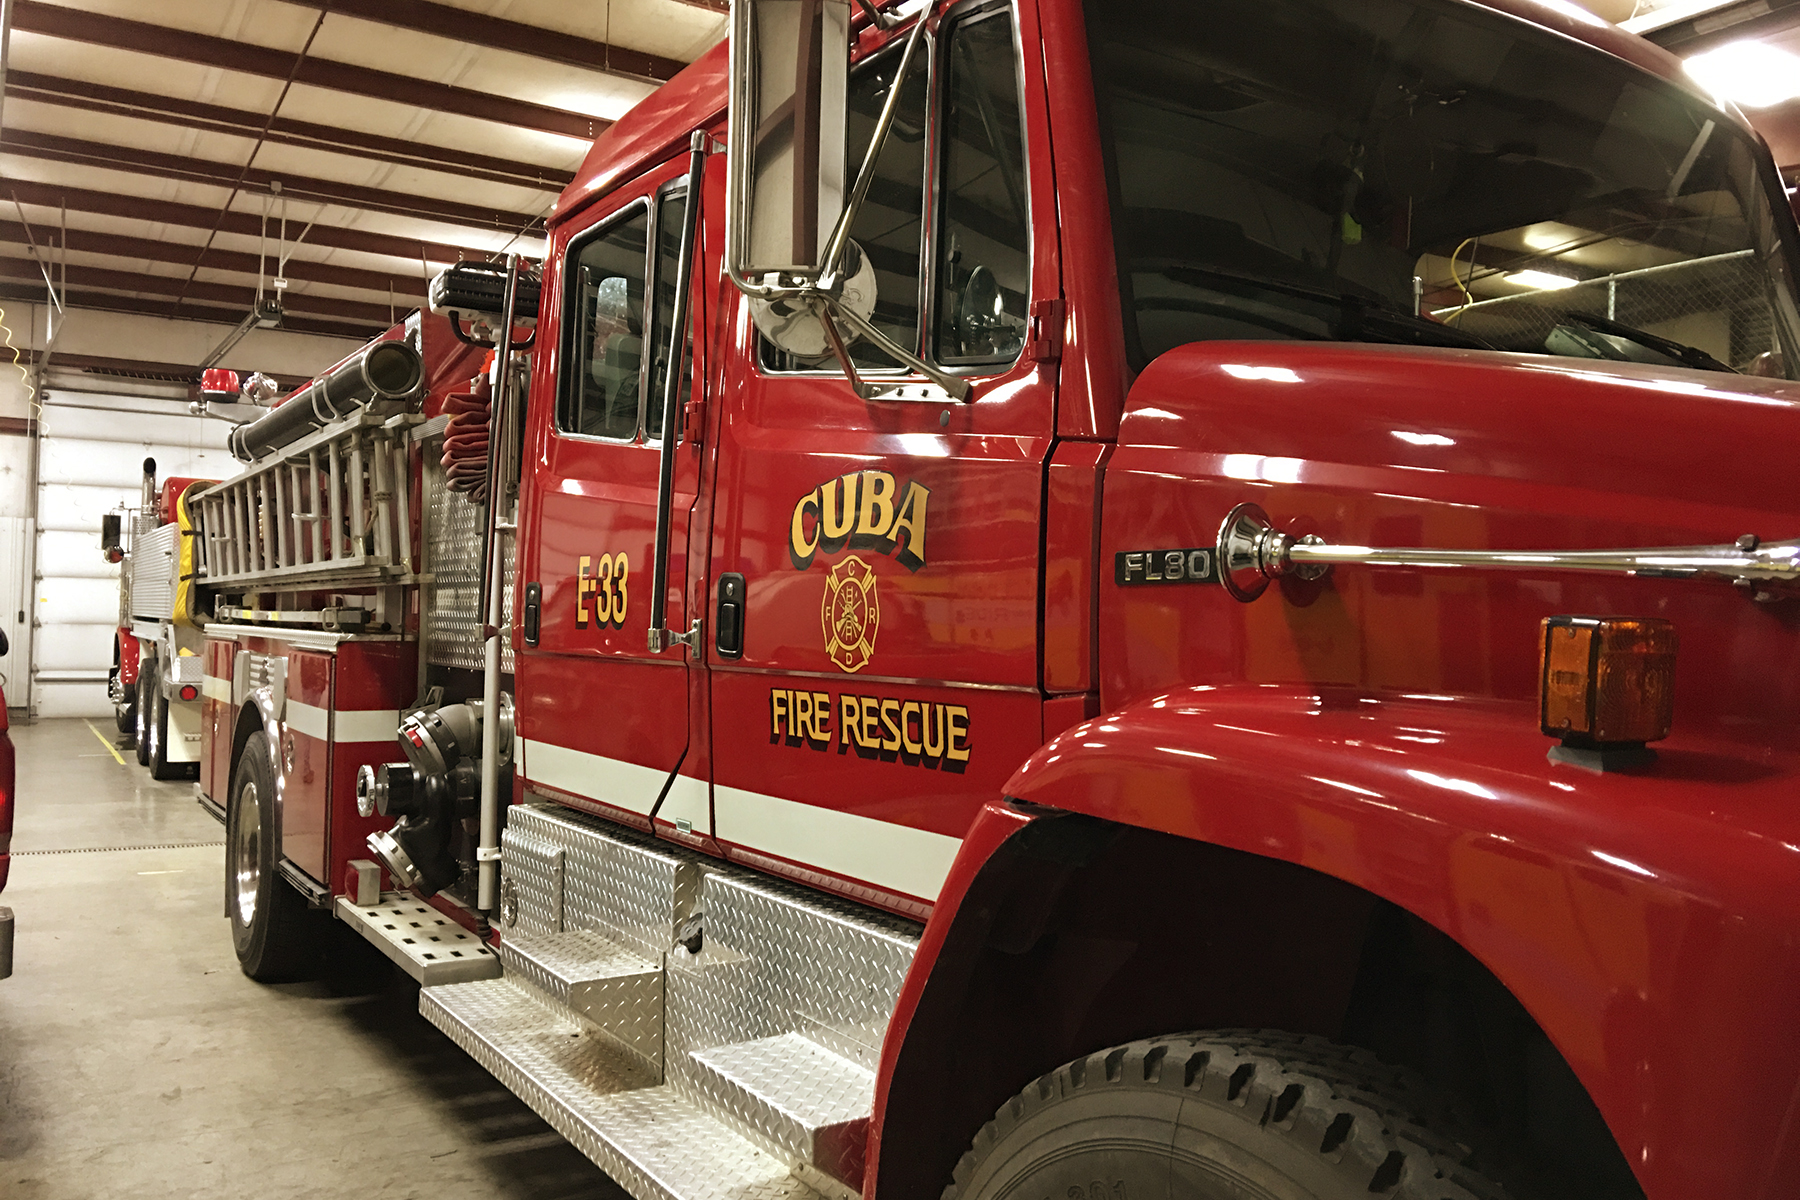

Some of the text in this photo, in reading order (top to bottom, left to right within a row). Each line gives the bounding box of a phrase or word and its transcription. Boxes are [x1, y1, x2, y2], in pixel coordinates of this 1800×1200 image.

[789, 469, 931, 564] CUBA
[847, 560, 856, 577] C
[1124, 550, 1211, 581] FL80
[577, 552, 629, 625] E-33
[825, 606, 877, 624] F R
[845, 652, 853, 665] D
[770, 688, 972, 763] FIRE RESCUE
